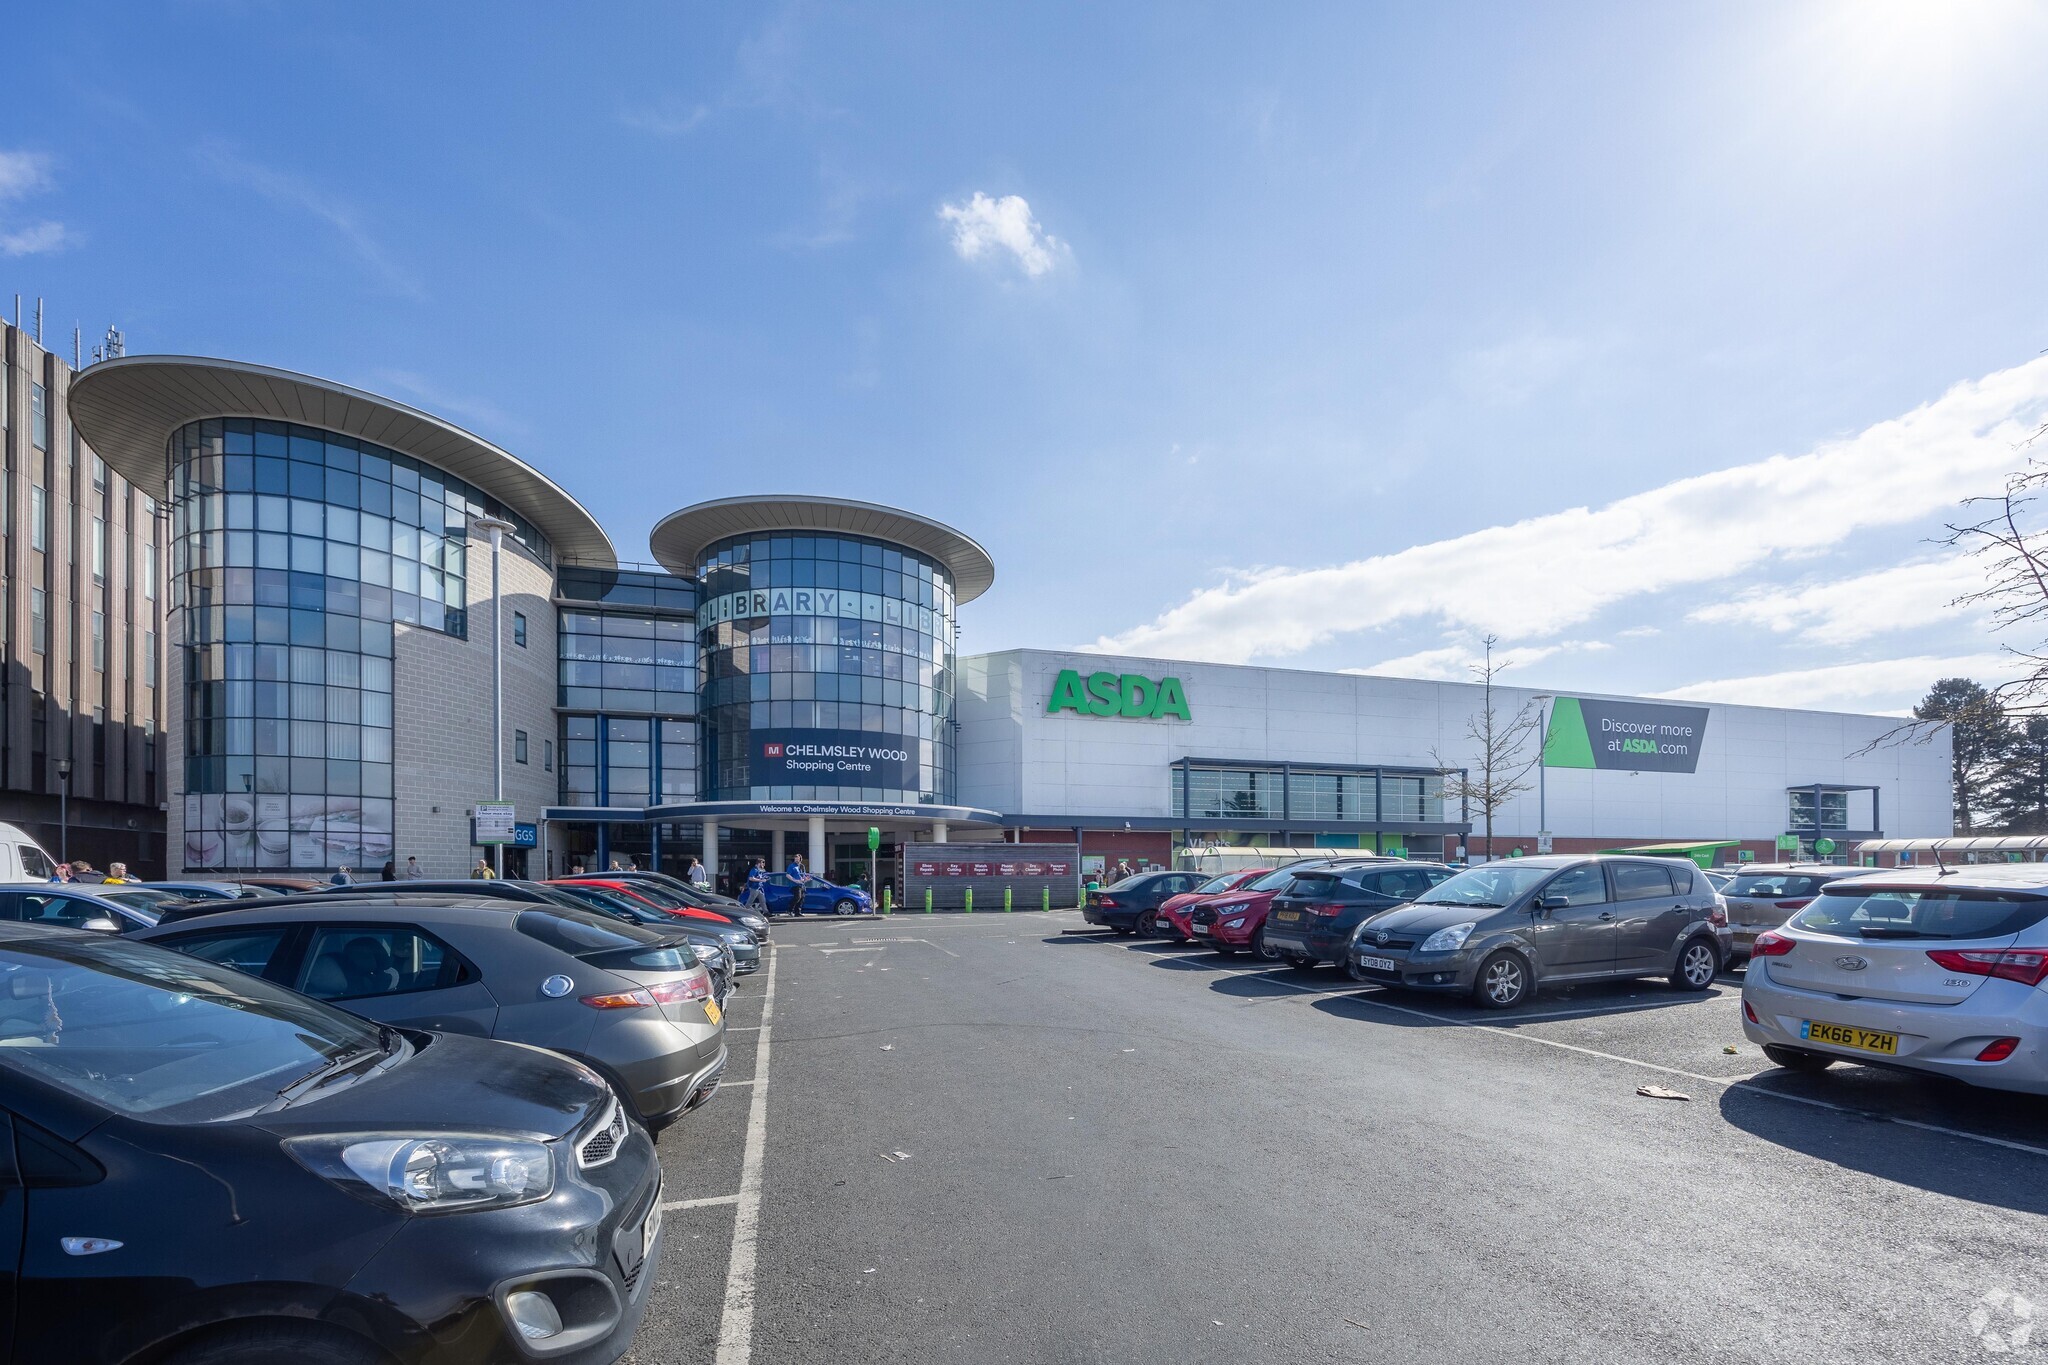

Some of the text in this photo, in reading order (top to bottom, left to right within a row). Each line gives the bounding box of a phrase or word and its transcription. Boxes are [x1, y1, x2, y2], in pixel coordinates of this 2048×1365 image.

[709, 592, 835, 621] LIBRARY
[1046, 669, 1192, 721] ASDA
[1602, 718, 1693, 737] Discover more
[768, 744, 908, 762] M CHELMSLEY WOOD
[1608, 738, 1688, 755] at ASDA.com
[786, 759, 872, 772] Shopping Centre
[759, 805, 916, 815] Welcome to Chelmsley Wood Shopping Centre
[515, 829, 534, 841] GGS
[1363, 956, 1379, 967] SY08
[1810, 1023, 1894, 1051] EK66 YZH
